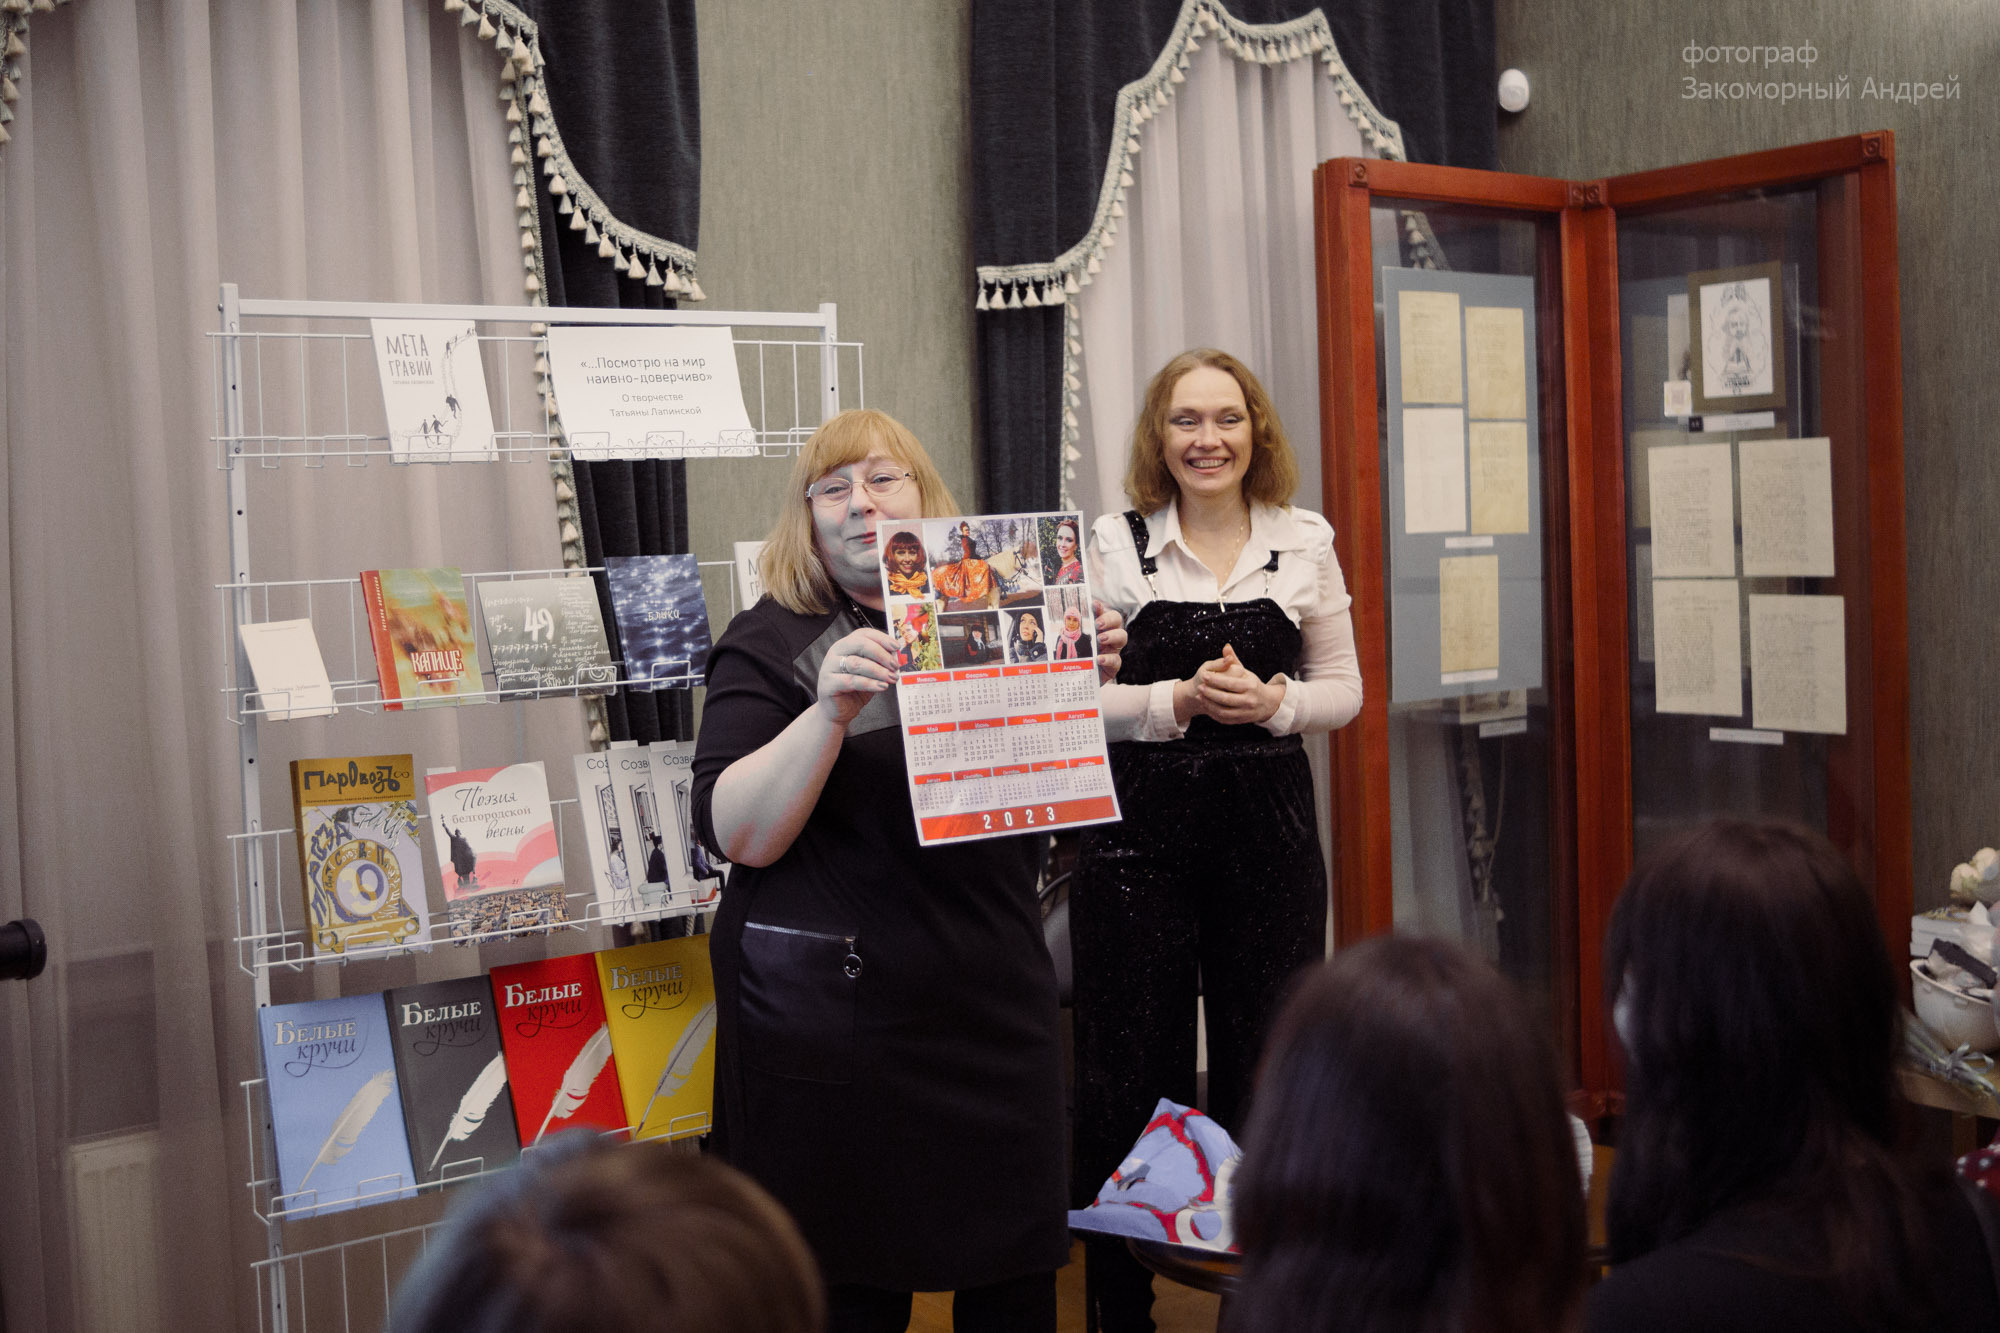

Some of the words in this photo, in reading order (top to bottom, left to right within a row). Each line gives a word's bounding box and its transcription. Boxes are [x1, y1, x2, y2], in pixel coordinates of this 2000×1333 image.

[386, 334, 429, 357] МЕТА
[389, 358, 433, 377] ГРАВИЙ
[664, 359, 678, 368] на
[682, 359, 706, 370] мир
[586, 372, 713, 386] наивно-доверчиво»
[622, 394, 628, 402] О
[631, 394, 684, 404] творчестве
[610, 408, 649, 418] Татьяны
[650, 406, 702, 417] Лапинской
[524, 606, 555, 642] 49
[648, 610, 680, 621] БЛИКИ
[410, 650, 462, 675] КАПИЩЕ
[454, 786, 518, 812] Поэзия
[451, 806, 532, 825] белгородской
[485, 820, 526, 840] весны
[627, 982, 683, 1011] кручи
[522, 1000, 582, 1029] кручи
[419, 1018, 482, 1048] кручи
[290, 1038, 356, 1071] кручи
